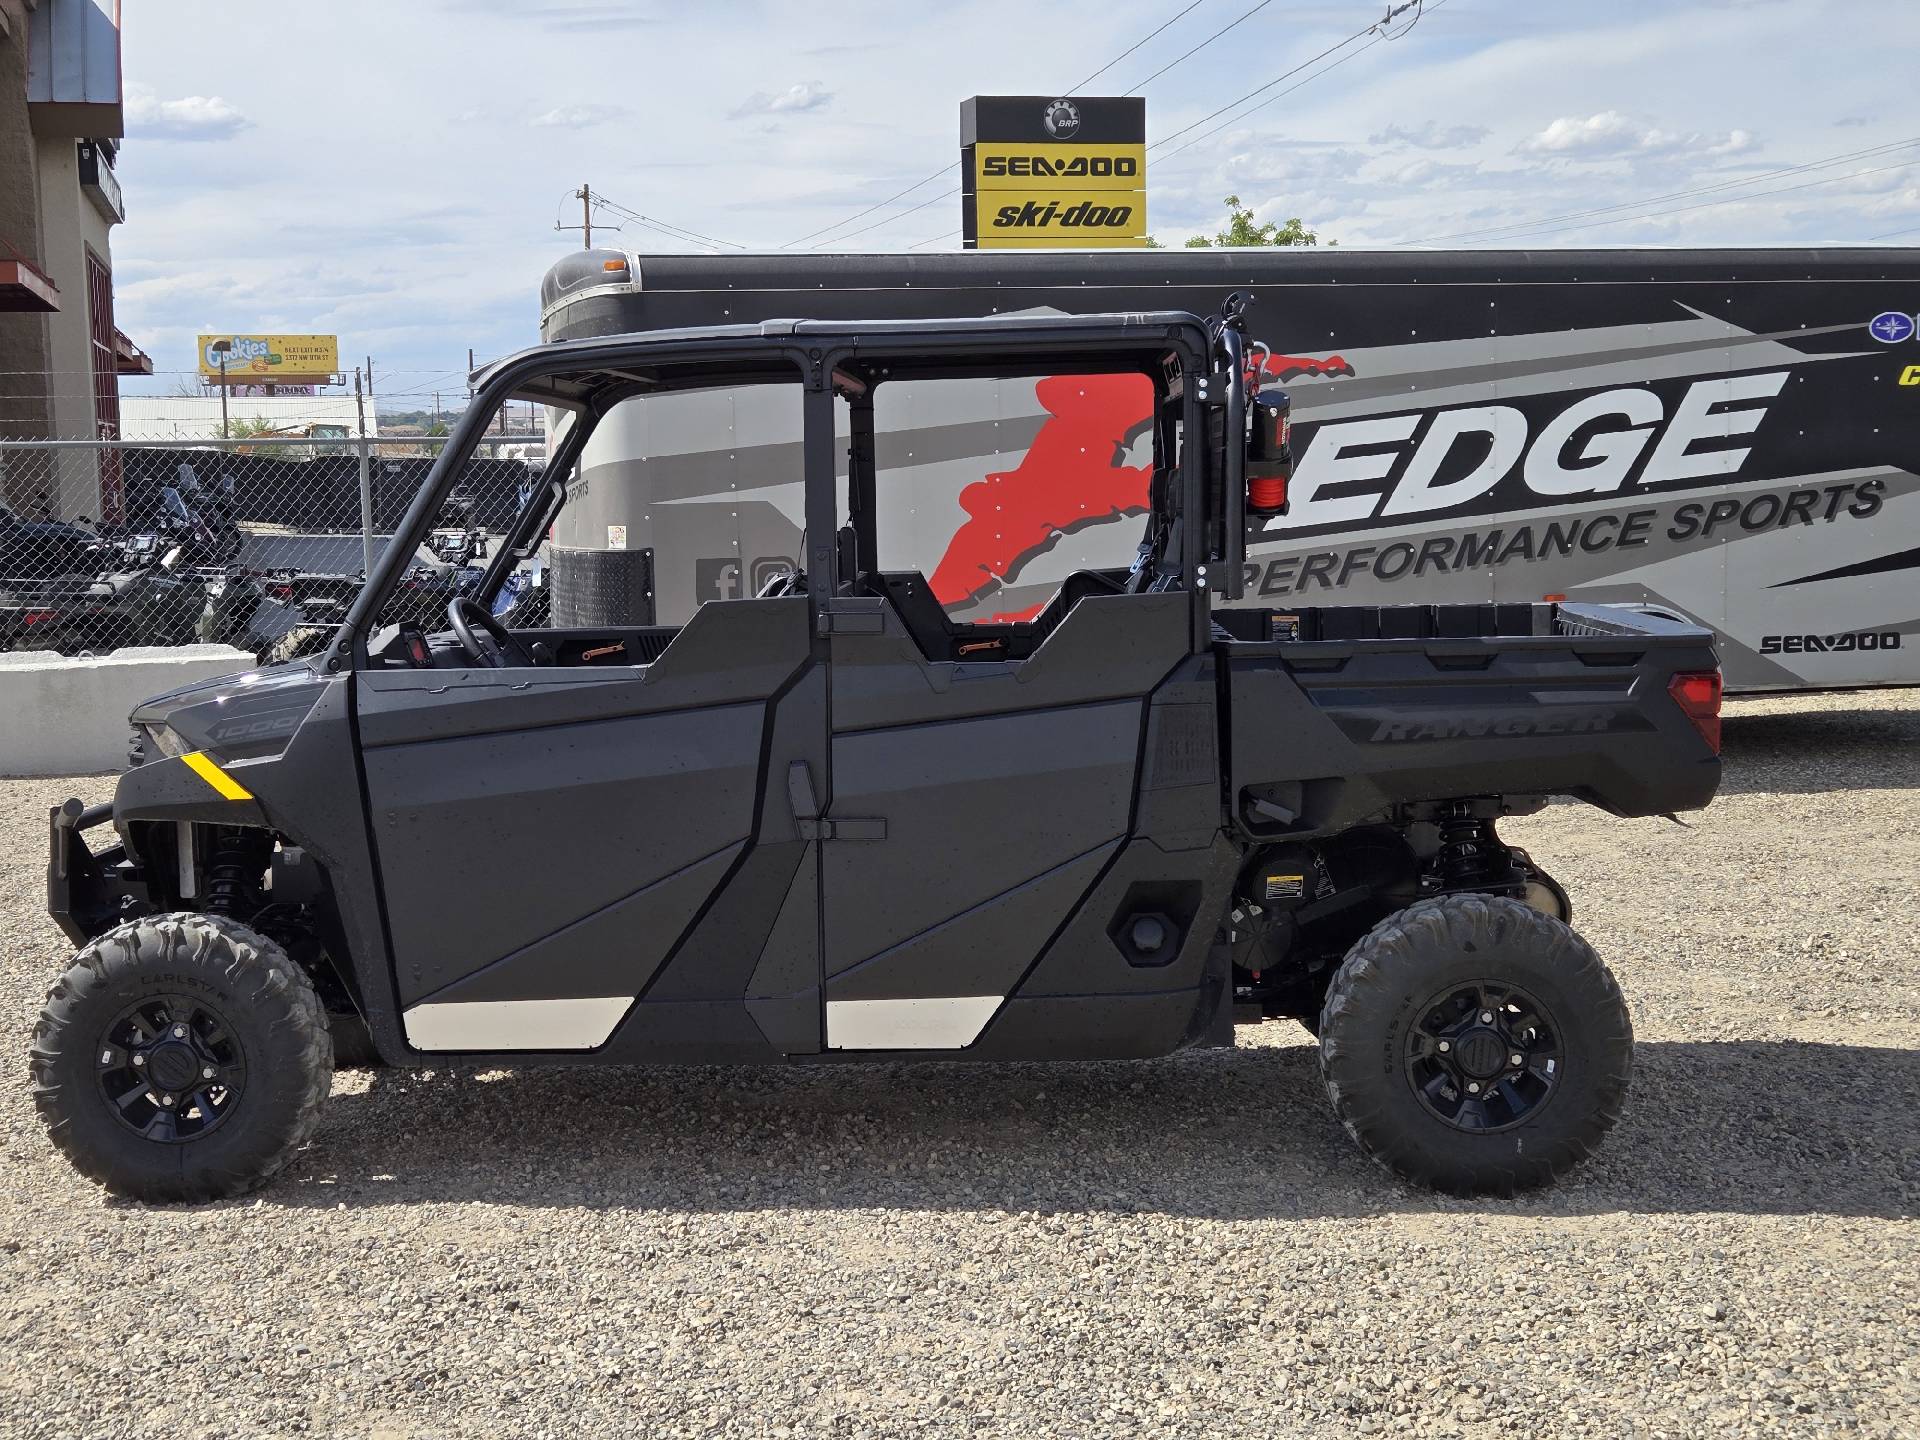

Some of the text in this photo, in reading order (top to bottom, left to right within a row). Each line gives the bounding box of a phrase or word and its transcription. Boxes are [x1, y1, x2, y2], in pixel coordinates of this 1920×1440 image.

[1058, 119, 1079, 127] BRP
[992, 201, 1133, 227] ski-doo
[1263, 371, 1791, 531] EDGE
[568, 480, 589, 505] SPORTS
[1667, 479, 1885, 542] SPORTS
